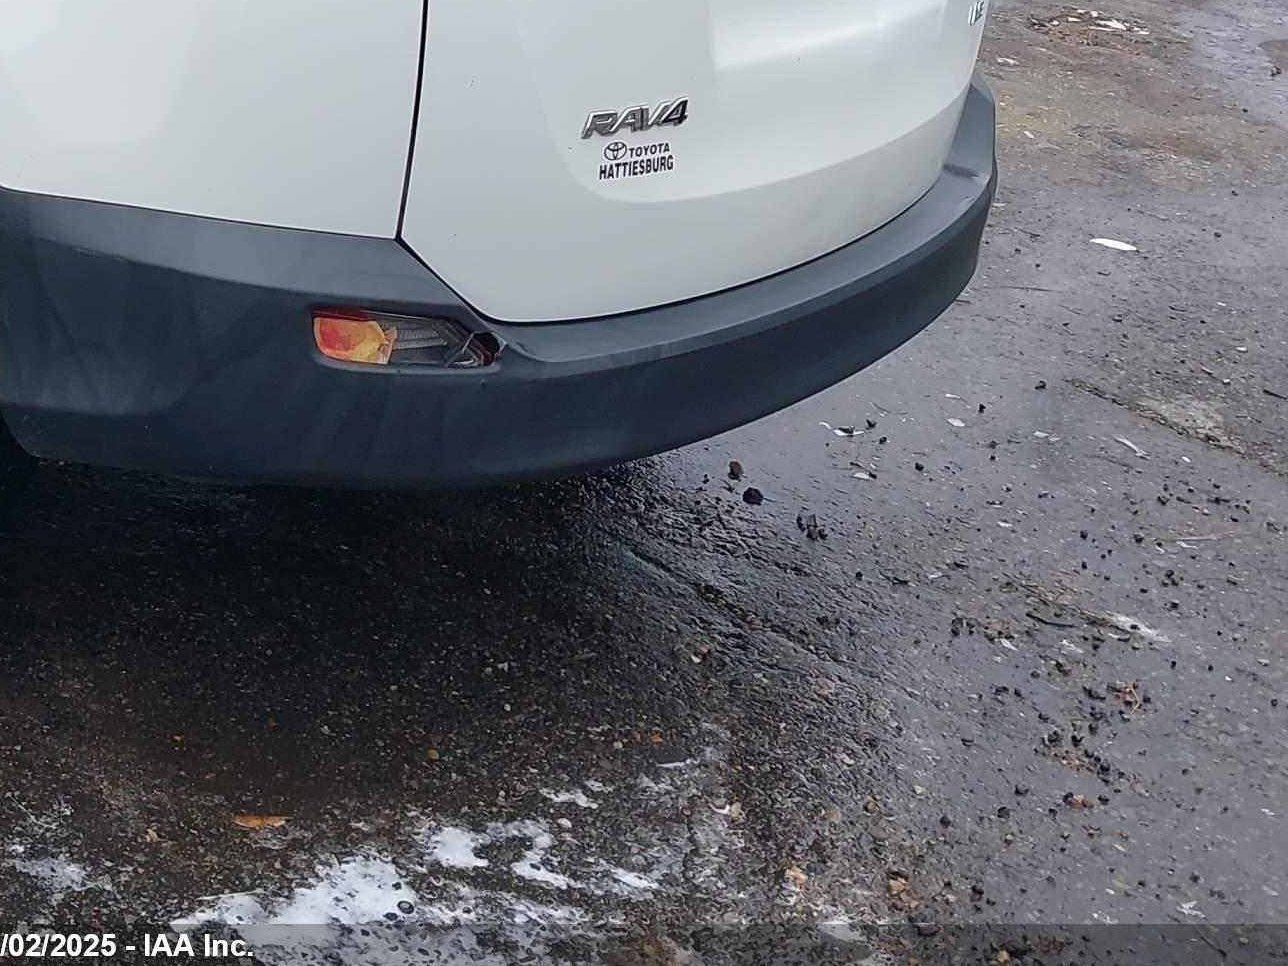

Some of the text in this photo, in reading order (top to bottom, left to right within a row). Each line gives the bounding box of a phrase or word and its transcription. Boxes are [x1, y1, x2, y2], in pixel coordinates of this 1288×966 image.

[581, 96, 689, 140] RAV4
[628, 142, 670, 159] TOYOTA
[599, 155, 674, 180] HATTIESBURG
